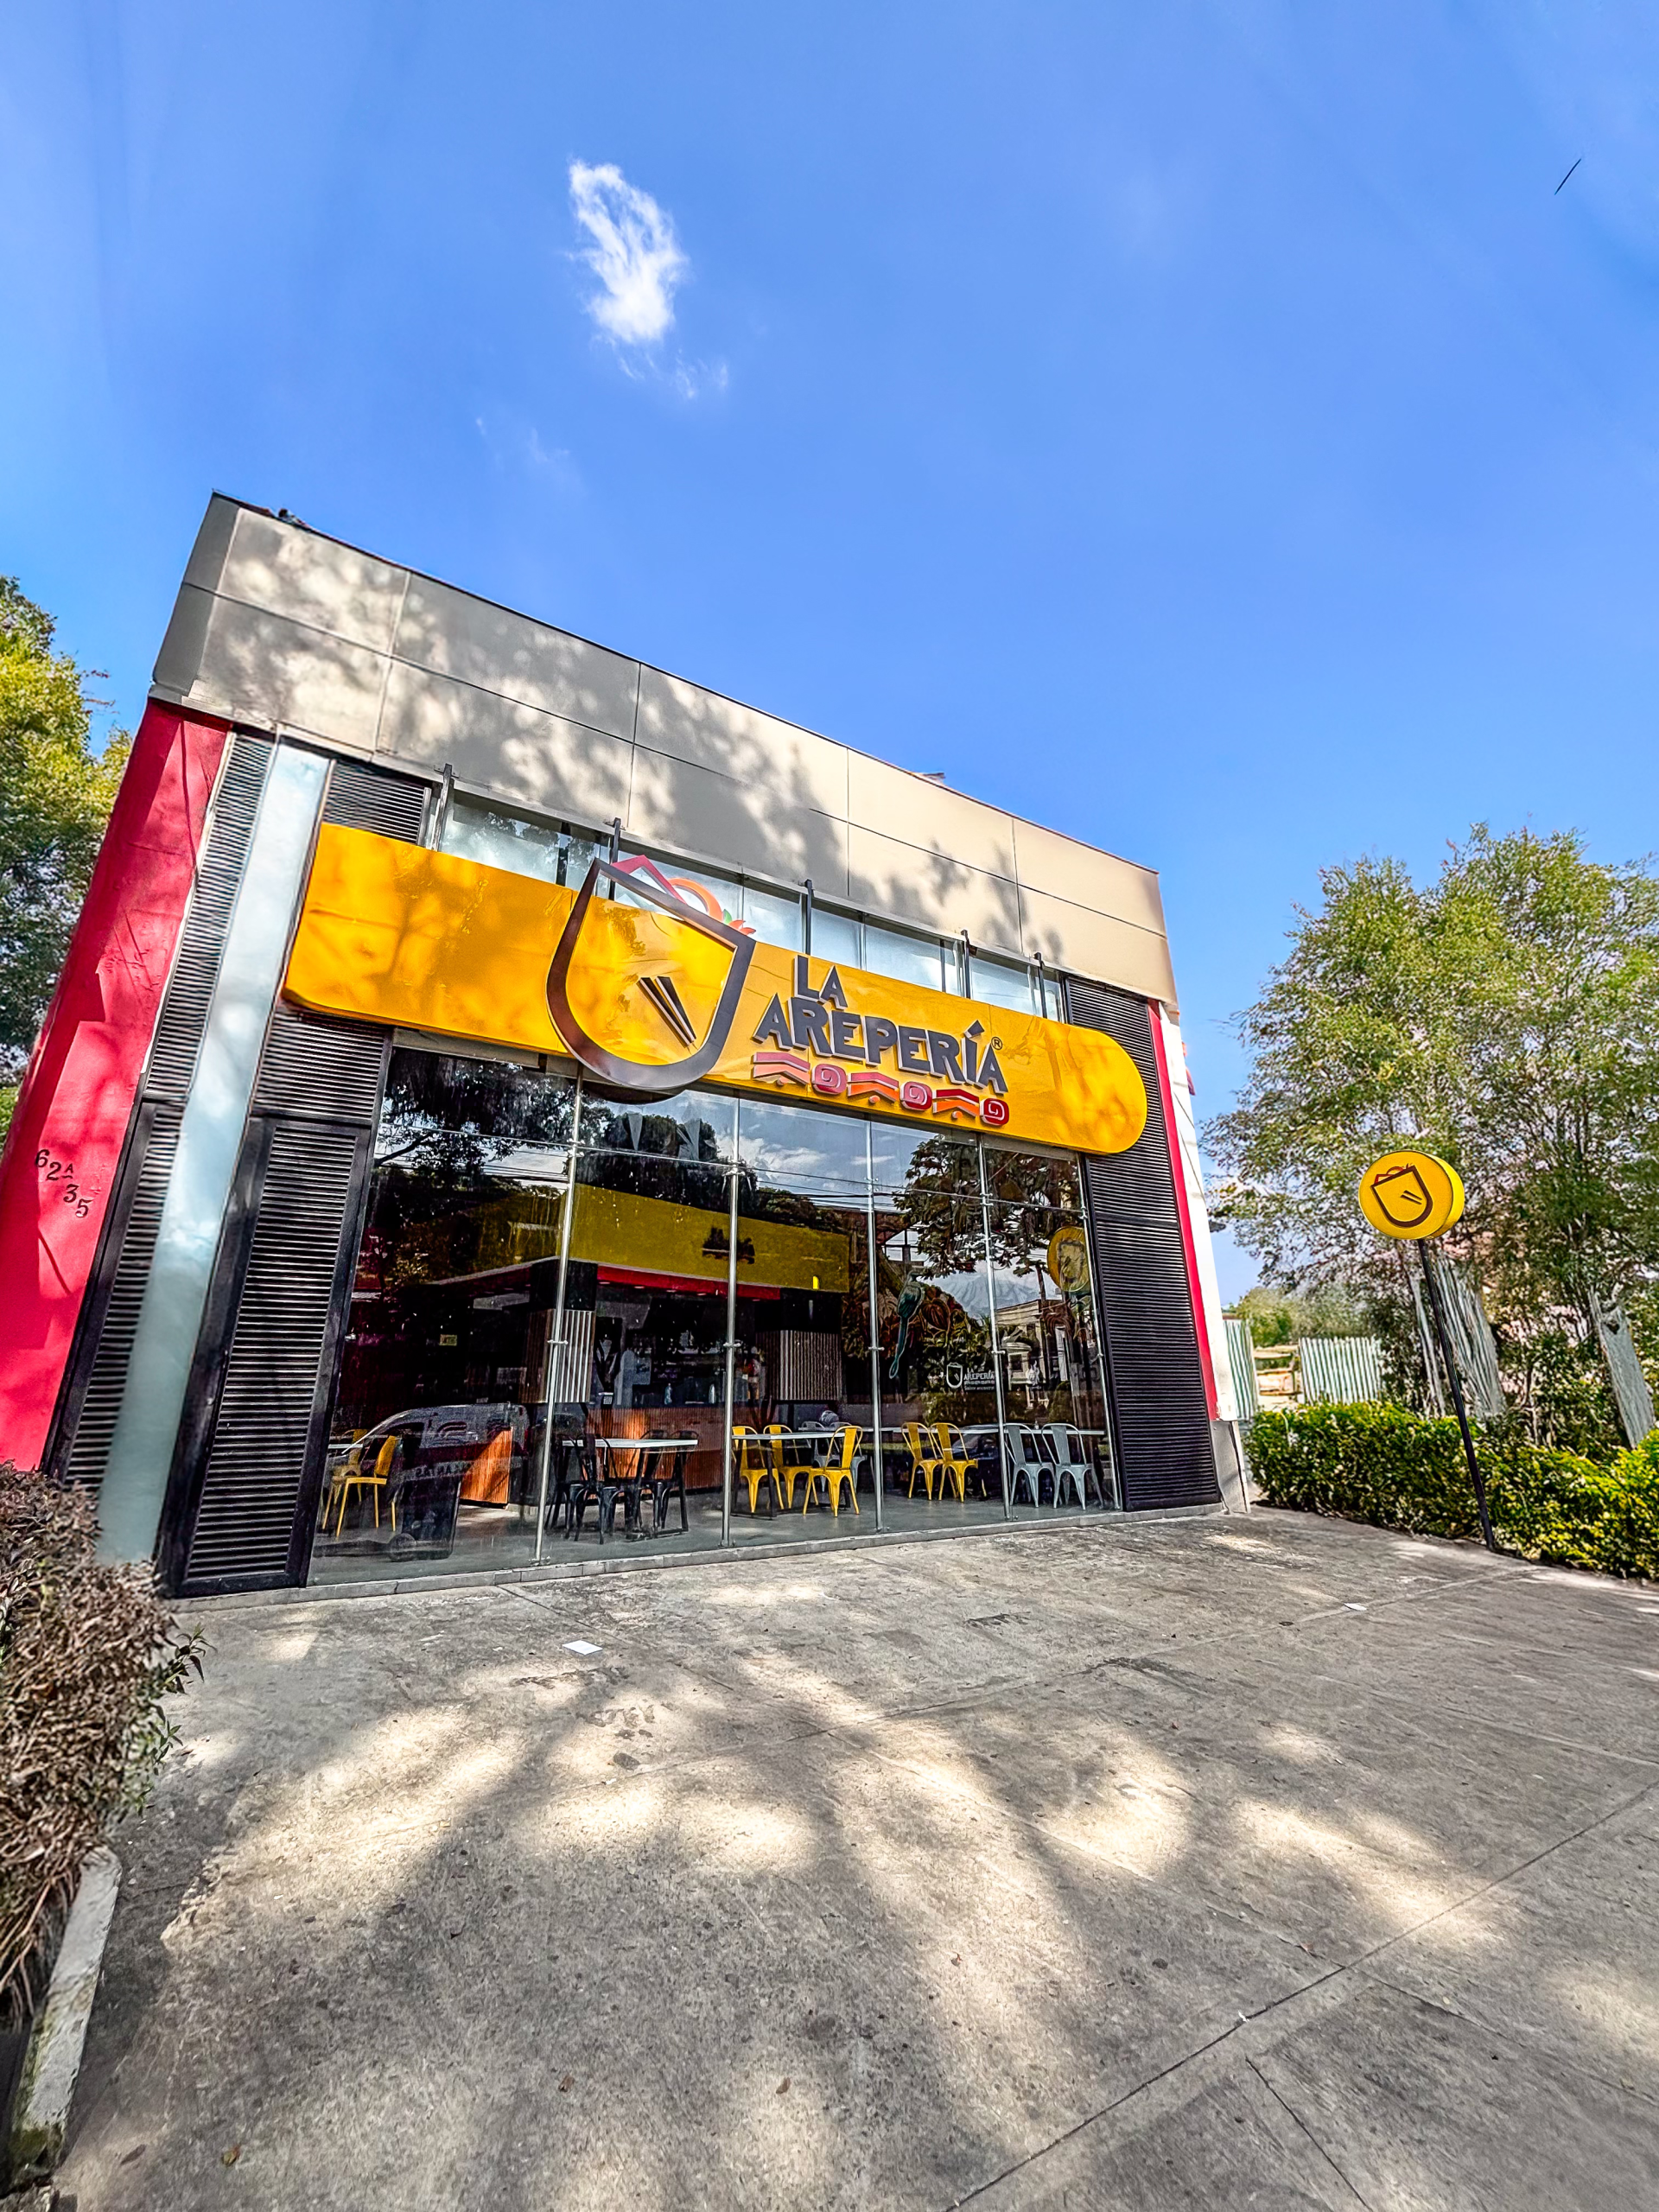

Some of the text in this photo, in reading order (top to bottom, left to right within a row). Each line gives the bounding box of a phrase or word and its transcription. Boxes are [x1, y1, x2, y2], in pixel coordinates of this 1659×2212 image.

[793, 955, 848, 1011] LA
[752, 992, 1008, 1094] AREPERÍA
[63, 1184, 92, 1217] 35
